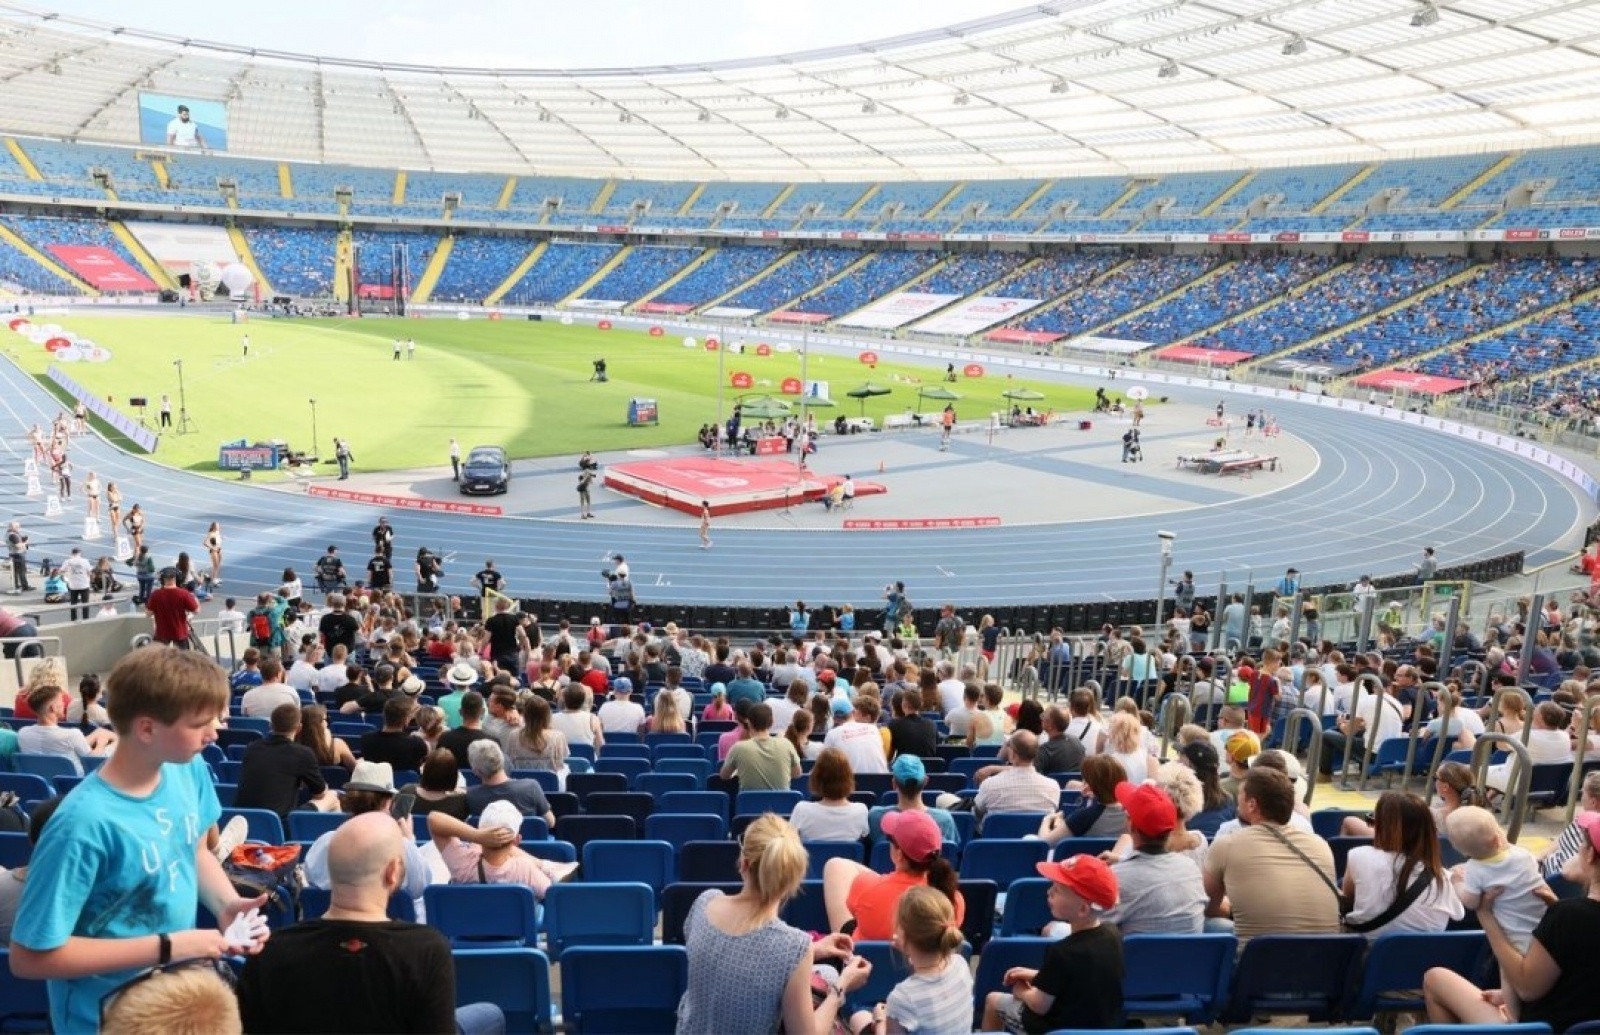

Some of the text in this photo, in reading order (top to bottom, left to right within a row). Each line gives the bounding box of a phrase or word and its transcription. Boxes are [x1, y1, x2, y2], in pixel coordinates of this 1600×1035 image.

[120, 542, 128, 554] 8
[156, 807, 173, 835] S
[141, 842, 161, 874] U
